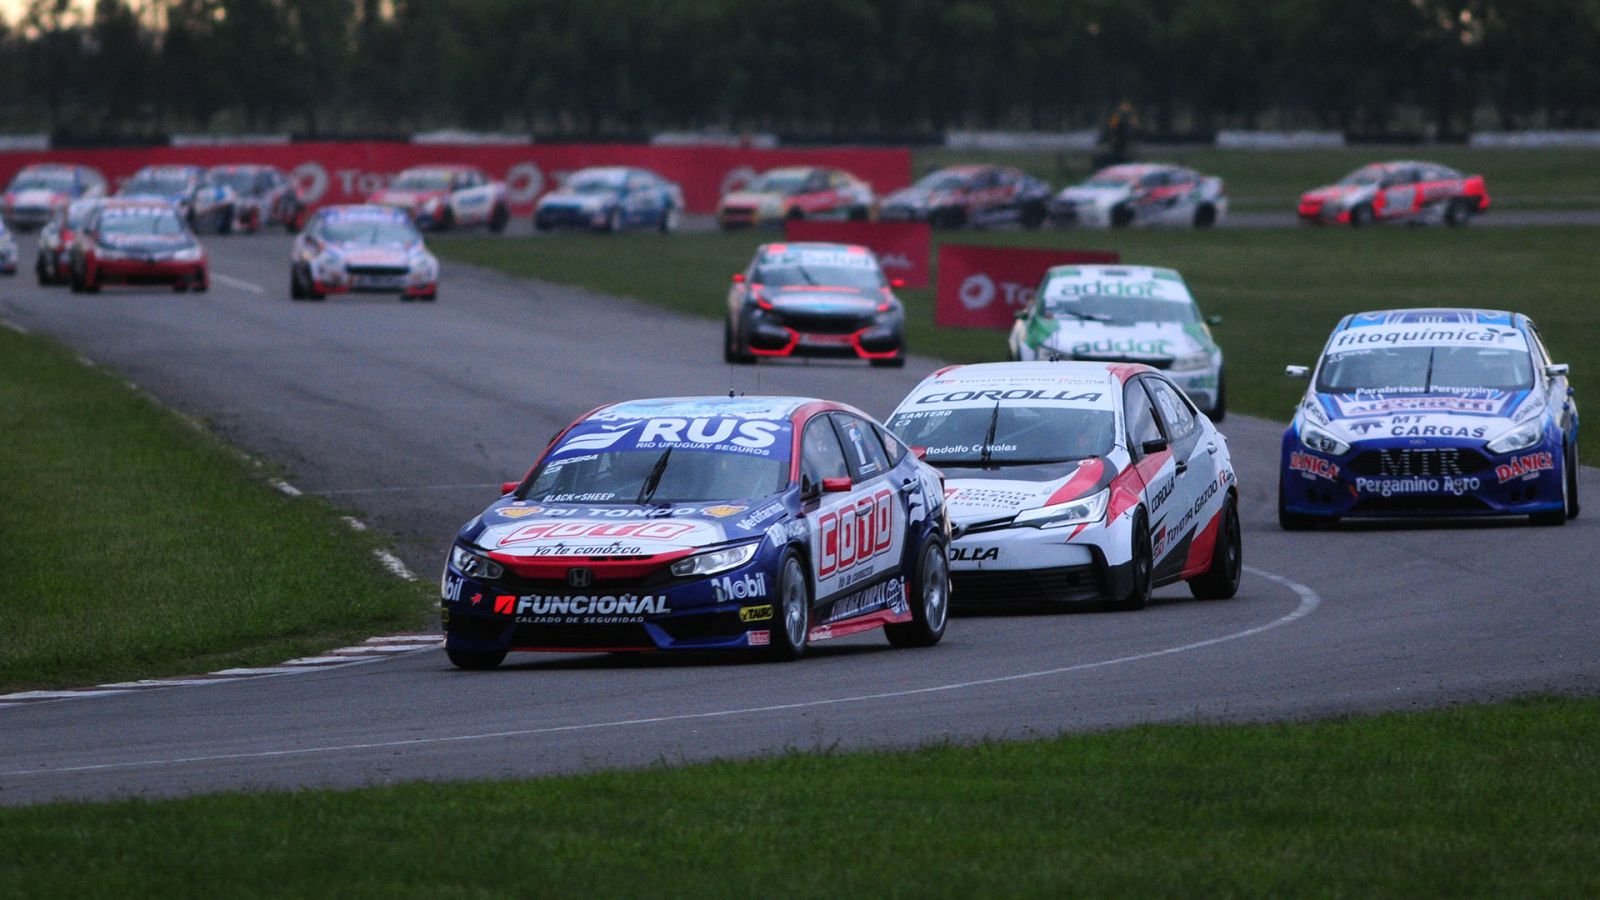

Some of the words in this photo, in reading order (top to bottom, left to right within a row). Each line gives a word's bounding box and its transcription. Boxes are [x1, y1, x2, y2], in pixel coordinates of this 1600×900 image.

[916, 390, 1103, 405] COROLLA
[1356, 385, 1423, 395] Parabrisas
[1391, 416, 1425, 424] MT
[638, 418, 781, 449] RUS
[1391, 426, 1485, 438] CARGAS
[635, 441, 657, 449] RIO
[715, 444, 770, 456] SEGUROS
[926, 444, 969, 456] Rodolfo
[1380, 448, 1463, 476] MTR
[1355, 475, 1439, 497] Pergamino
[1443, 476, 1480, 496] Agro
[580, 493, 616, 501] SHEEP
[544, 509, 571, 517] DI
[499, 522, 696, 547] COTO
[818, 488, 893, 580] COTO
[711, 572, 767, 603] Mobil
[516, 594, 673, 616] FUNCIONAL
[514, 616, 563, 624] CALZADO
[566, 616, 577, 624] DE
[583, 616, 644, 625] SEGURIDAD
